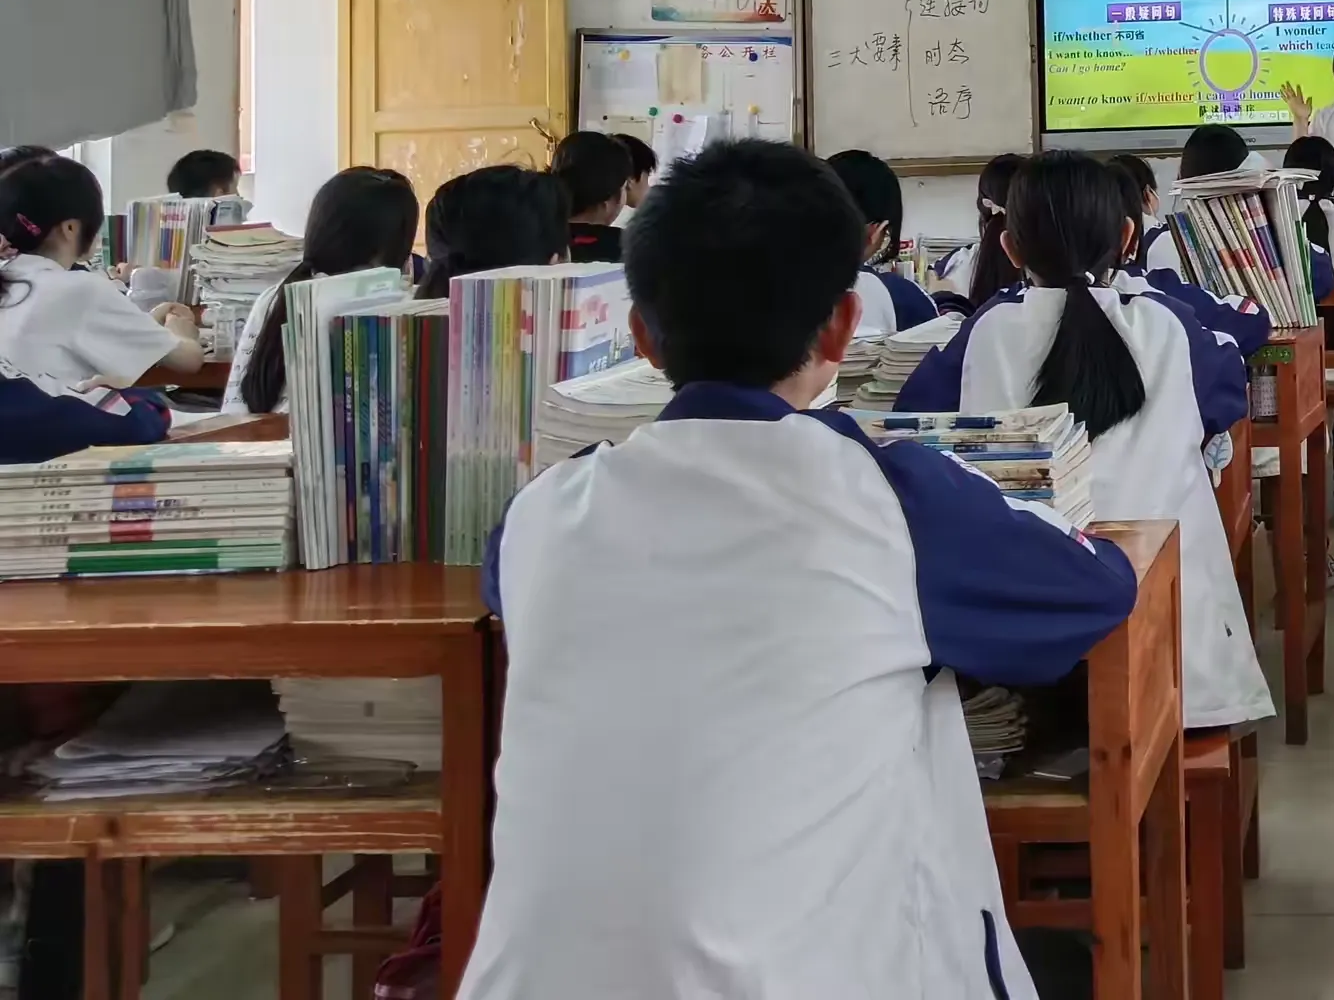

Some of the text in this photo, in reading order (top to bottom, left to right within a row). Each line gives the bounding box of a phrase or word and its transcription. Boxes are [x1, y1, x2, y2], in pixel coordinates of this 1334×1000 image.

[1111, 4, 1176, 21] 一般疑问句
[1053, 30, 1145, 42] if/whether 不可省
[1276, 25, 1327, 37] I wonder
[827, 32, 903, 72] 三大要素
[925, 37, 970, 67] 时态
[1278, 40, 1314, 51] which
[1056, 51, 1080, 60] want
[1083, 51, 1093, 60] to
[1049, 63, 1068, 74] Can
[1080, 65, 1091, 76] go
[1094, 62, 1127, 73] home?
[928, 84, 973, 120] 语序
[1048, 96, 1055, 106] I
[1057, 96, 1085, 106] want
[1087, 96, 1098, 105] to
[1101, 93, 1132, 105] know
[1136, 92, 1195, 104] if/whether
[1206, 92, 1226, 101] can
[1232, 92, 1246, 102] go
